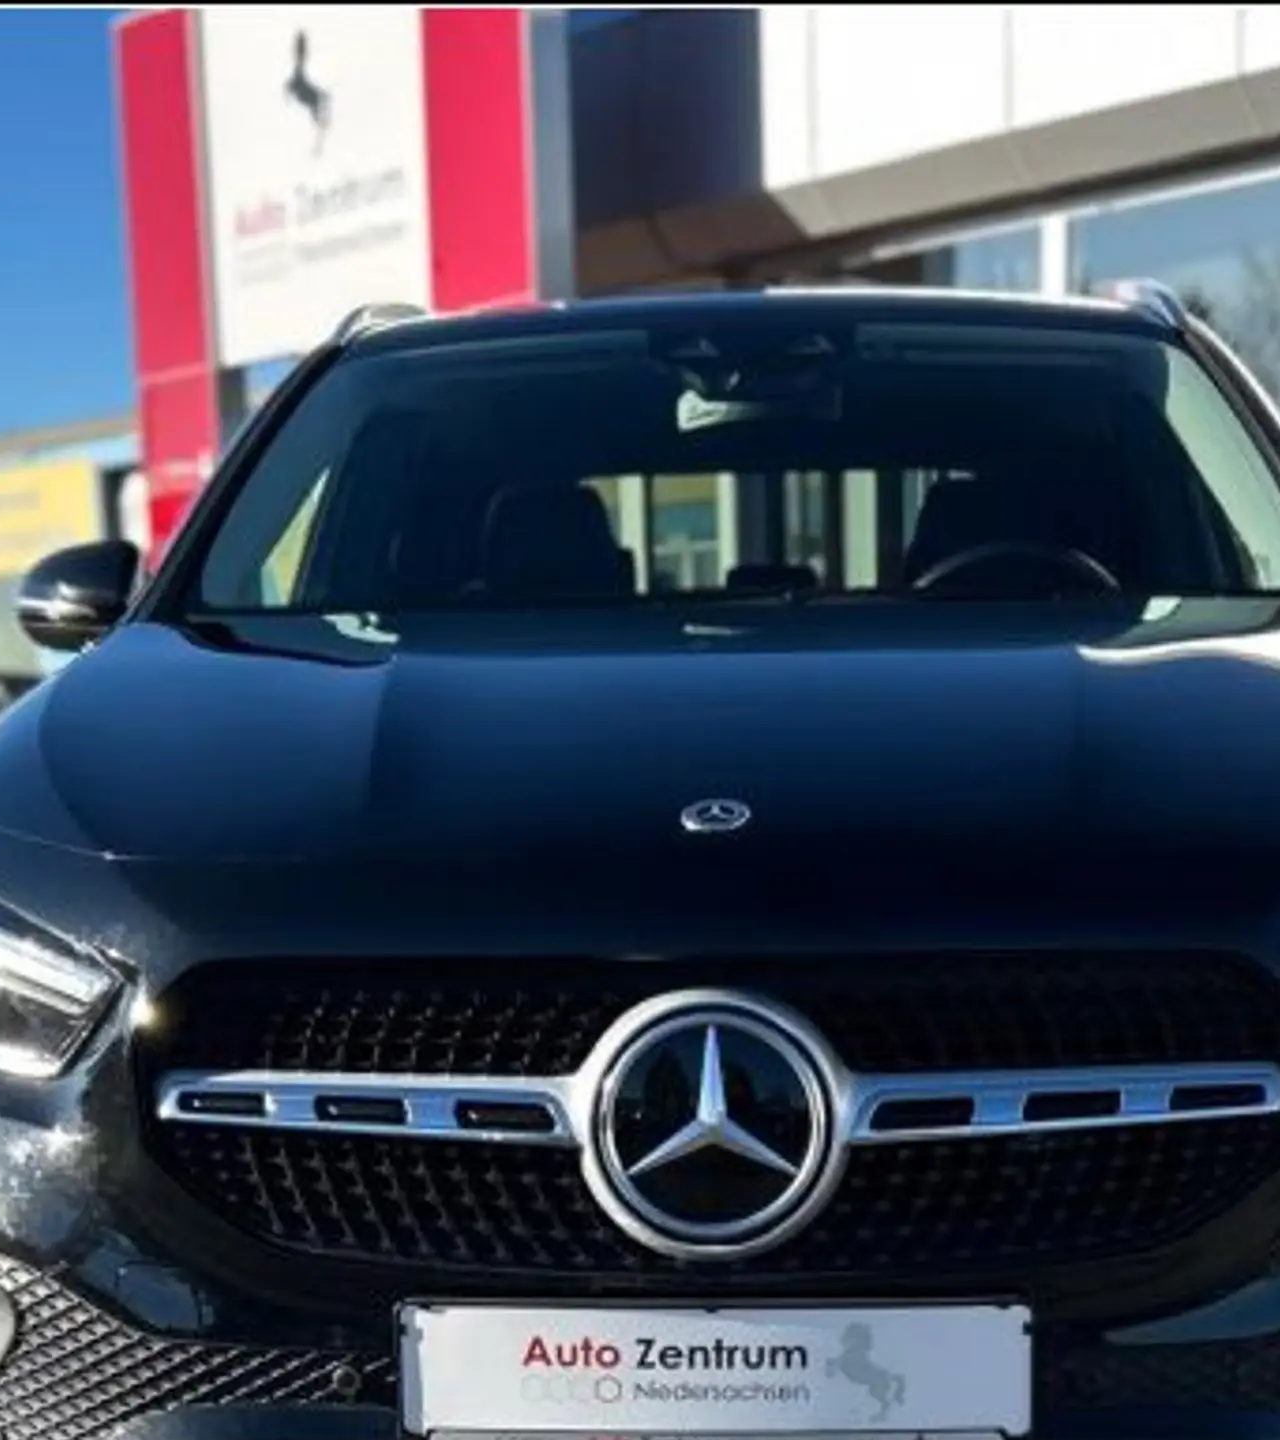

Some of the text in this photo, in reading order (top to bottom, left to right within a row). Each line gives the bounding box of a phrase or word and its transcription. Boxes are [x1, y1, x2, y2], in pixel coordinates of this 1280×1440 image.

[522, 1336, 809, 1371] Auto Zentrum
[632, 1380, 810, 1403] Niedersachsen
